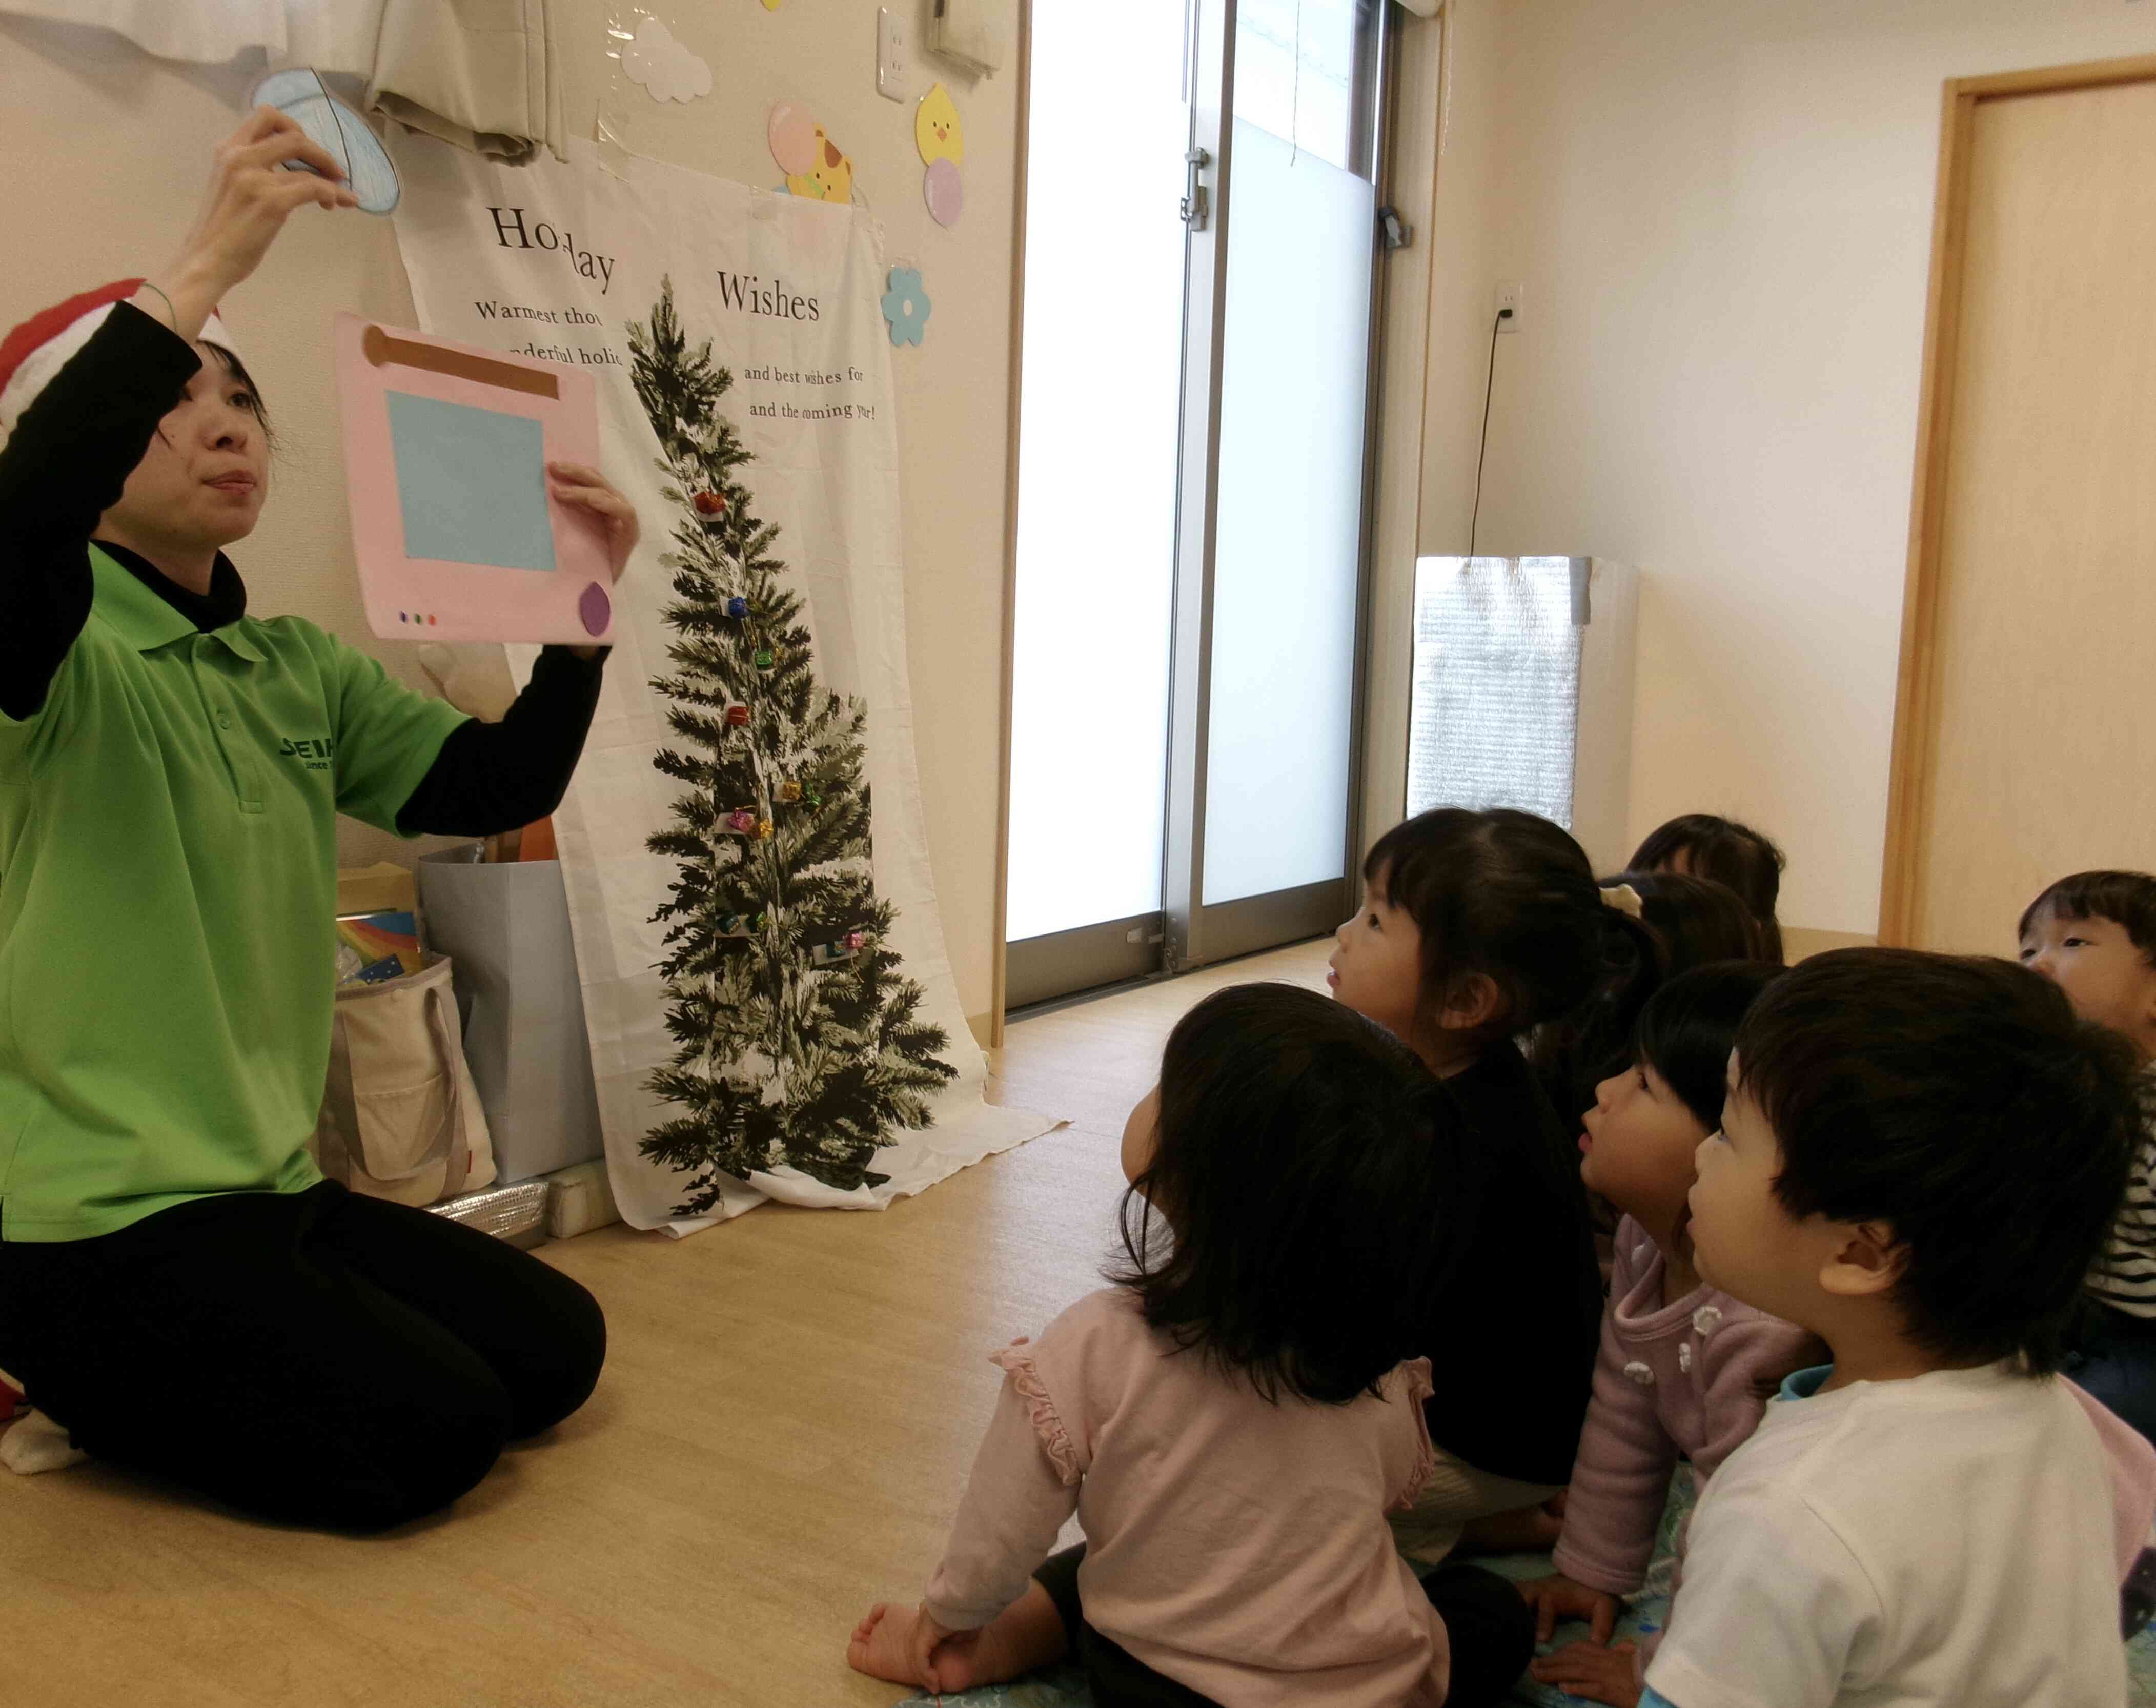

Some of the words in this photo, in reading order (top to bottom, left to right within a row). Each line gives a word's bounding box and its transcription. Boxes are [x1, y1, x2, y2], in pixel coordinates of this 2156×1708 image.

[486, 207, 615, 295] Hoday
[717, 271, 820, 321] Wishes
[474, 301, 558, 324] Warmest
[744, 365, 769, 380] and
[774, 367, 800, 385] best
[804, 371, 841, 384] wishes
[848, 366, 863, 381] for
[750, 402, 776, 417] and
[782, 402, 799, 418] the
[802, 404, 852, 419] coming
